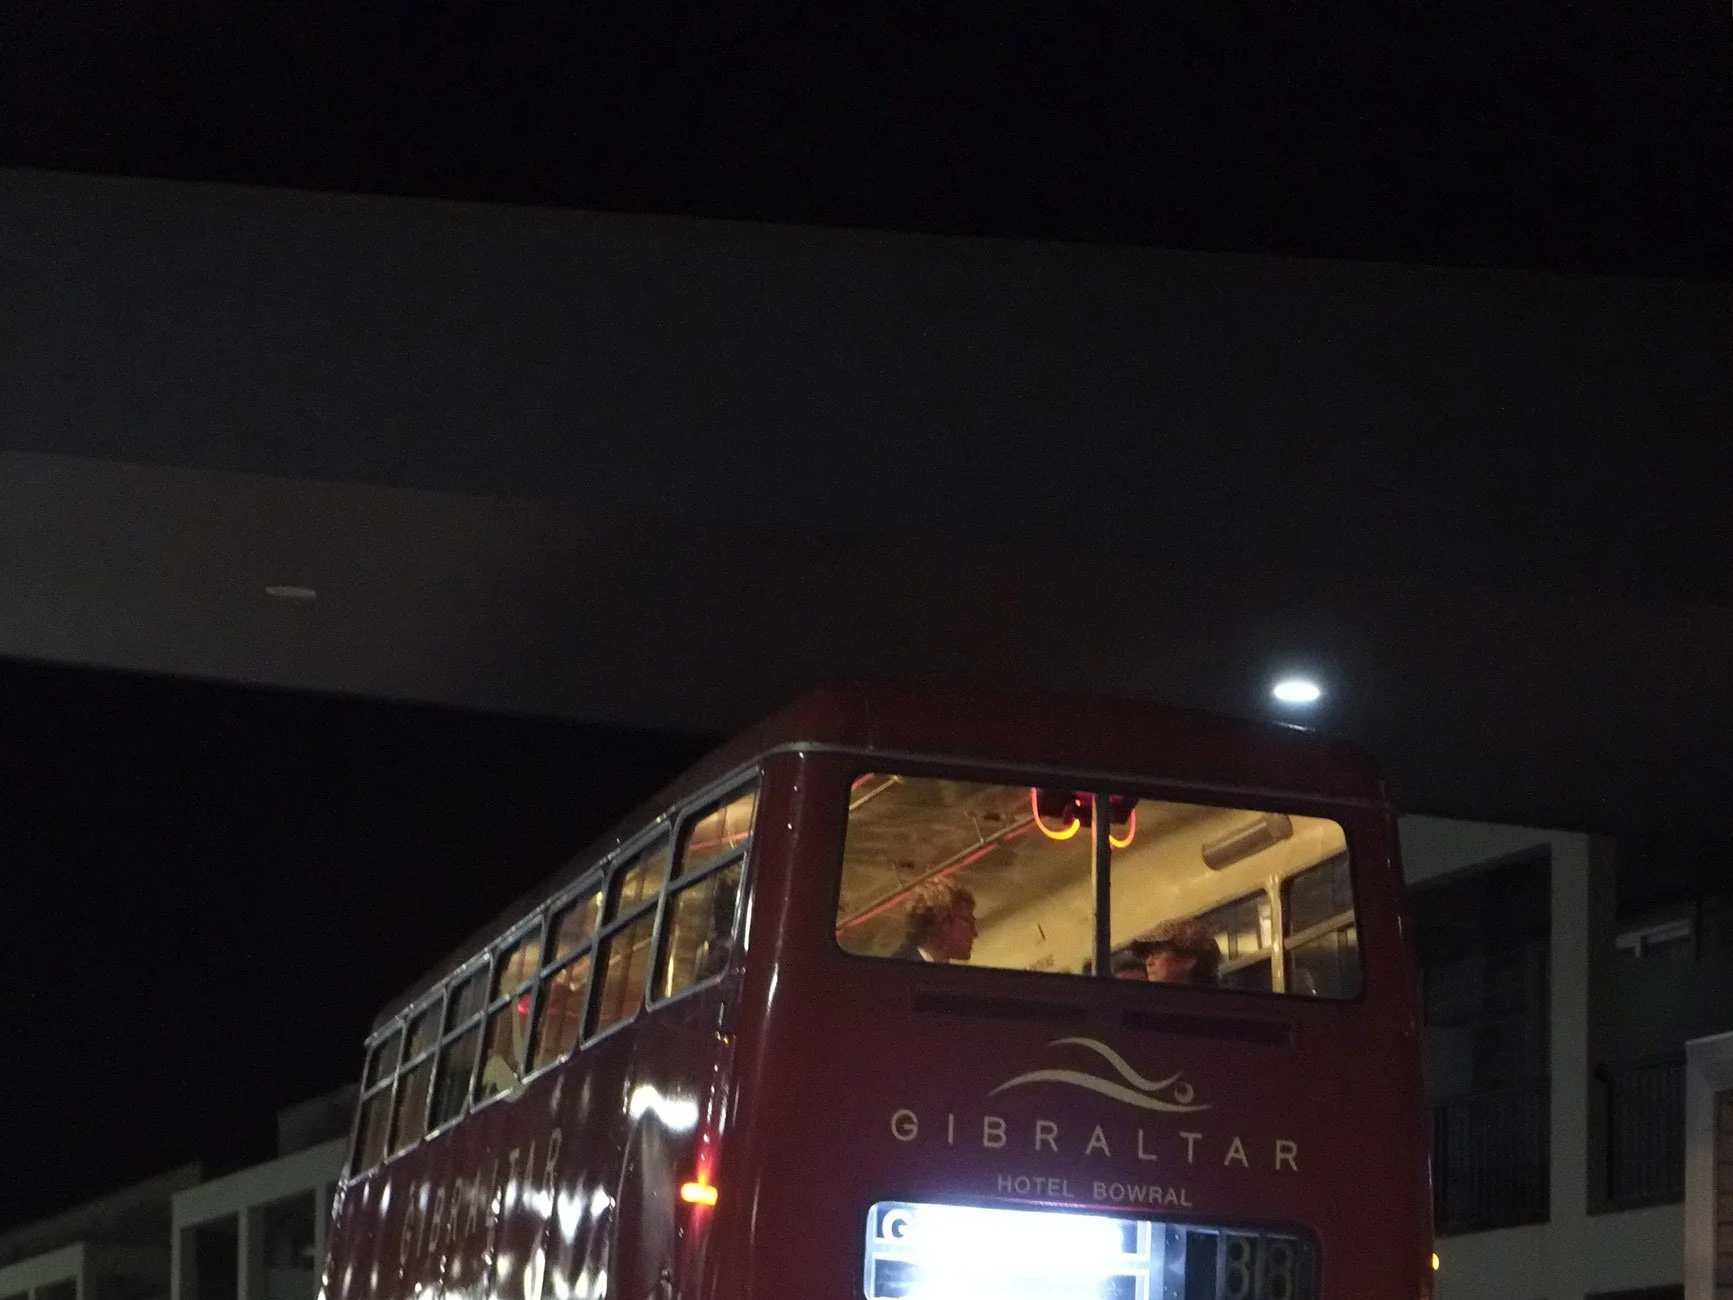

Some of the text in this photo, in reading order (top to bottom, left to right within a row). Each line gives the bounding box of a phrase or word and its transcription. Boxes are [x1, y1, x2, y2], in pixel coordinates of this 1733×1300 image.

[891, 1109, 1299, 1171] GIBRALTAR
[997, 1174, 1192, 1206] HOTEL BOWRAL
